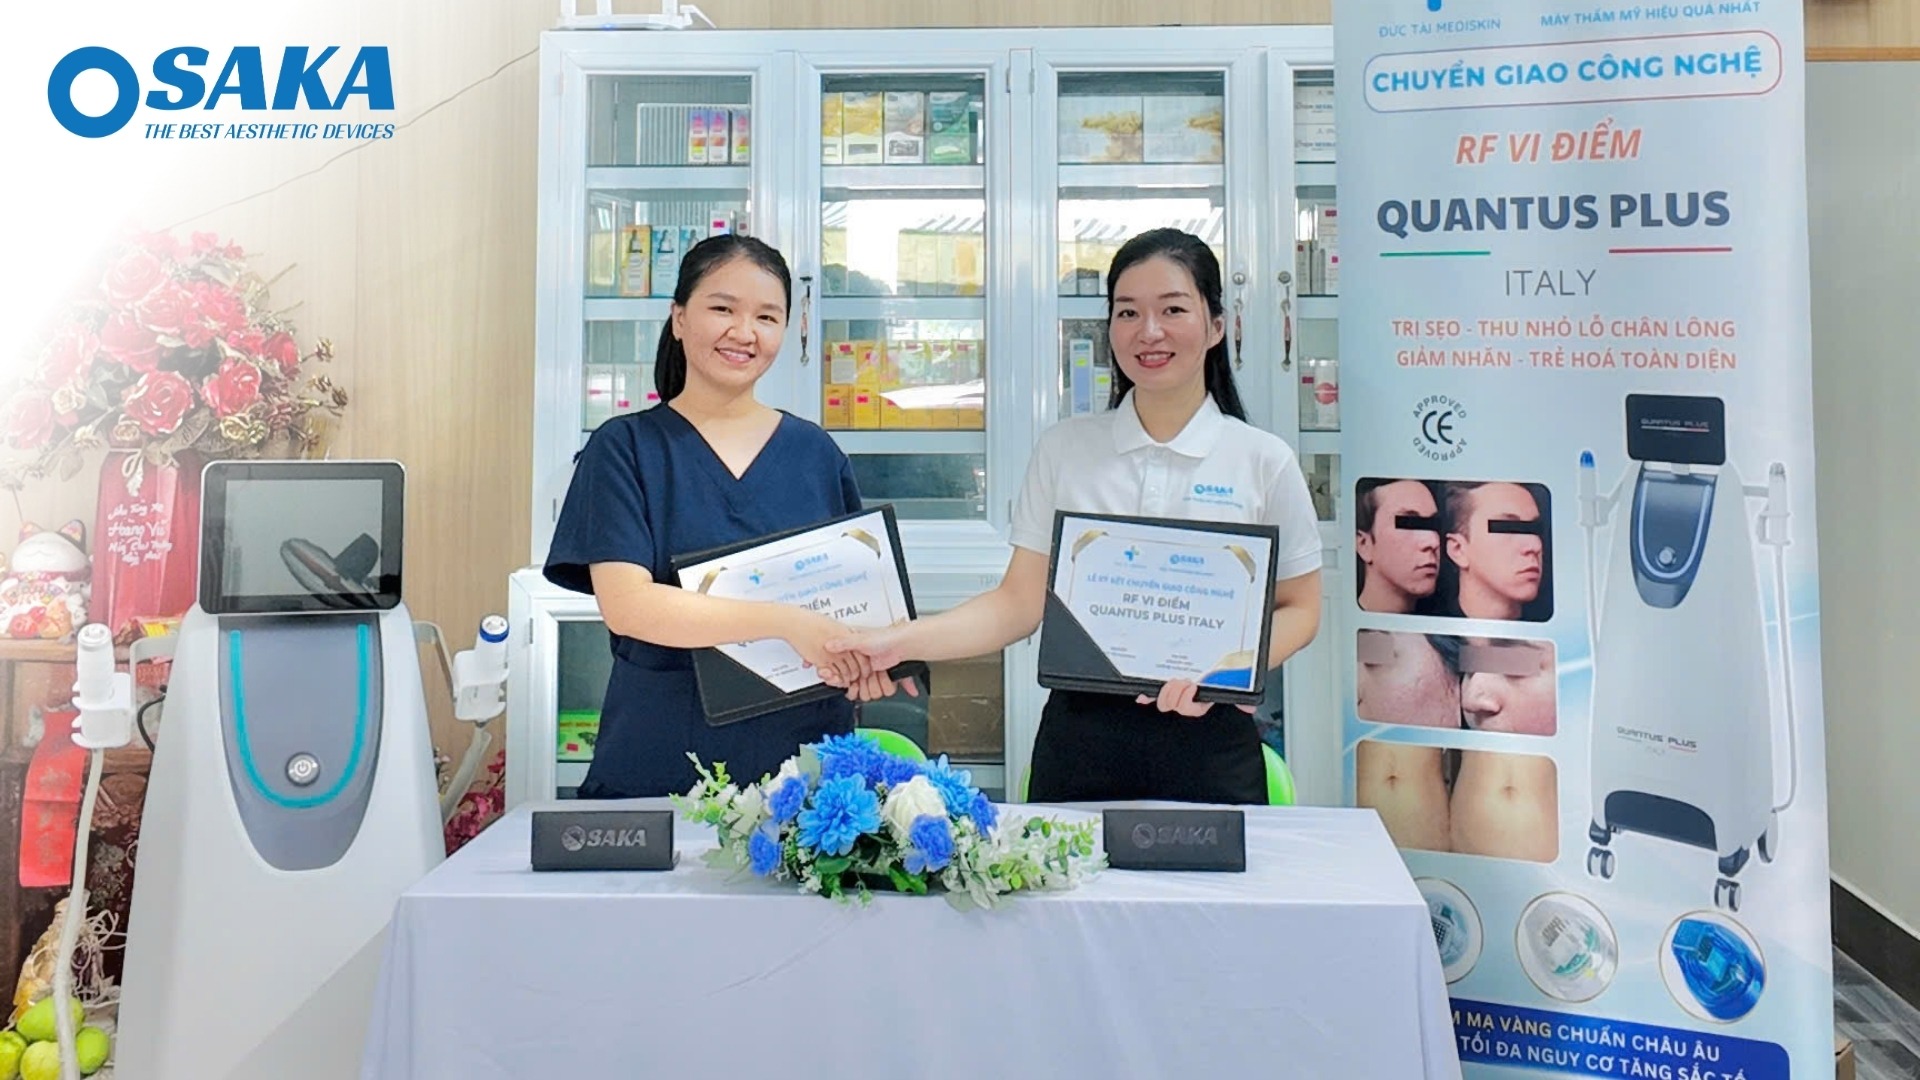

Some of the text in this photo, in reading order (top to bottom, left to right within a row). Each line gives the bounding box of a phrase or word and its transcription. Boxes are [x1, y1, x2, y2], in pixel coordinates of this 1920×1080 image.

[1437, 17, 1502, 34] MEDISKIN
[1645, 5, 1679, 21] HIỆU
[1372, 45, 1763, 94] CHUYỂN GIAO CÔNG NGHỆ
[1455, 117, 1642, 164] RF VI ĐIỂM
[1376, 190, 1731, 239] QUANTUS PLUS
[1505, 268, 1597, 297] ITALY
[1392, 320, 1420, 339] TRỊ
[1425, 320, 1460, 341] SẸO
[1478, 320, 1518, 337] THU
[1525, 313, 1571, 338] NHỎ
[1578, 312, 1603, 338] LỖ
[1610, 317, 1670, 338] CHÂN
[1675, 316, 1736, 339] LÔNG
[1396, 345, 1445, 368] GIẢM
[1452, 346, 1511, 368] NHĂN
[1529, 346, 1564, 368] TRẺ
[1571, 347, 1616, 369] HOÁ
[1620, 346, 1680, 369] TOÀN
[1685, 348, 1736, 372] DIỆN
[1412, 394, 1468, 419] APPROVED
[1412, 437, 1468, 462] APPROVED
[833, 601, 869, 620] ITALY
[1122, 593, 1139, 605] RF
[1141, 595, 1155, 606] VI
[1089, 603, 1225, 630] QUANTUS PLUS ITALY
[1616, 726, 1698, 749] QUANTUS PLUS
[1467, 1011, 1495, 1035] MẠ
[1499, 1014, 1552, 1039] VÀNG
[1557, 1024, 1627, 1049] CHUẨN
[1632, 1035, 1687, 1058] CHÂU
[1692, 1039, 1720, 1062] ÂU
[1460, 1030, 1491, 1055] TỐI
[1496, 1041, 1522, 1059] ĐA
[1528, 1046, 1581, 1068] NGUY
[1586, 1054, 1614, 1073] CƠ
[1619, 1057, 1673, 1080] TĂNG
